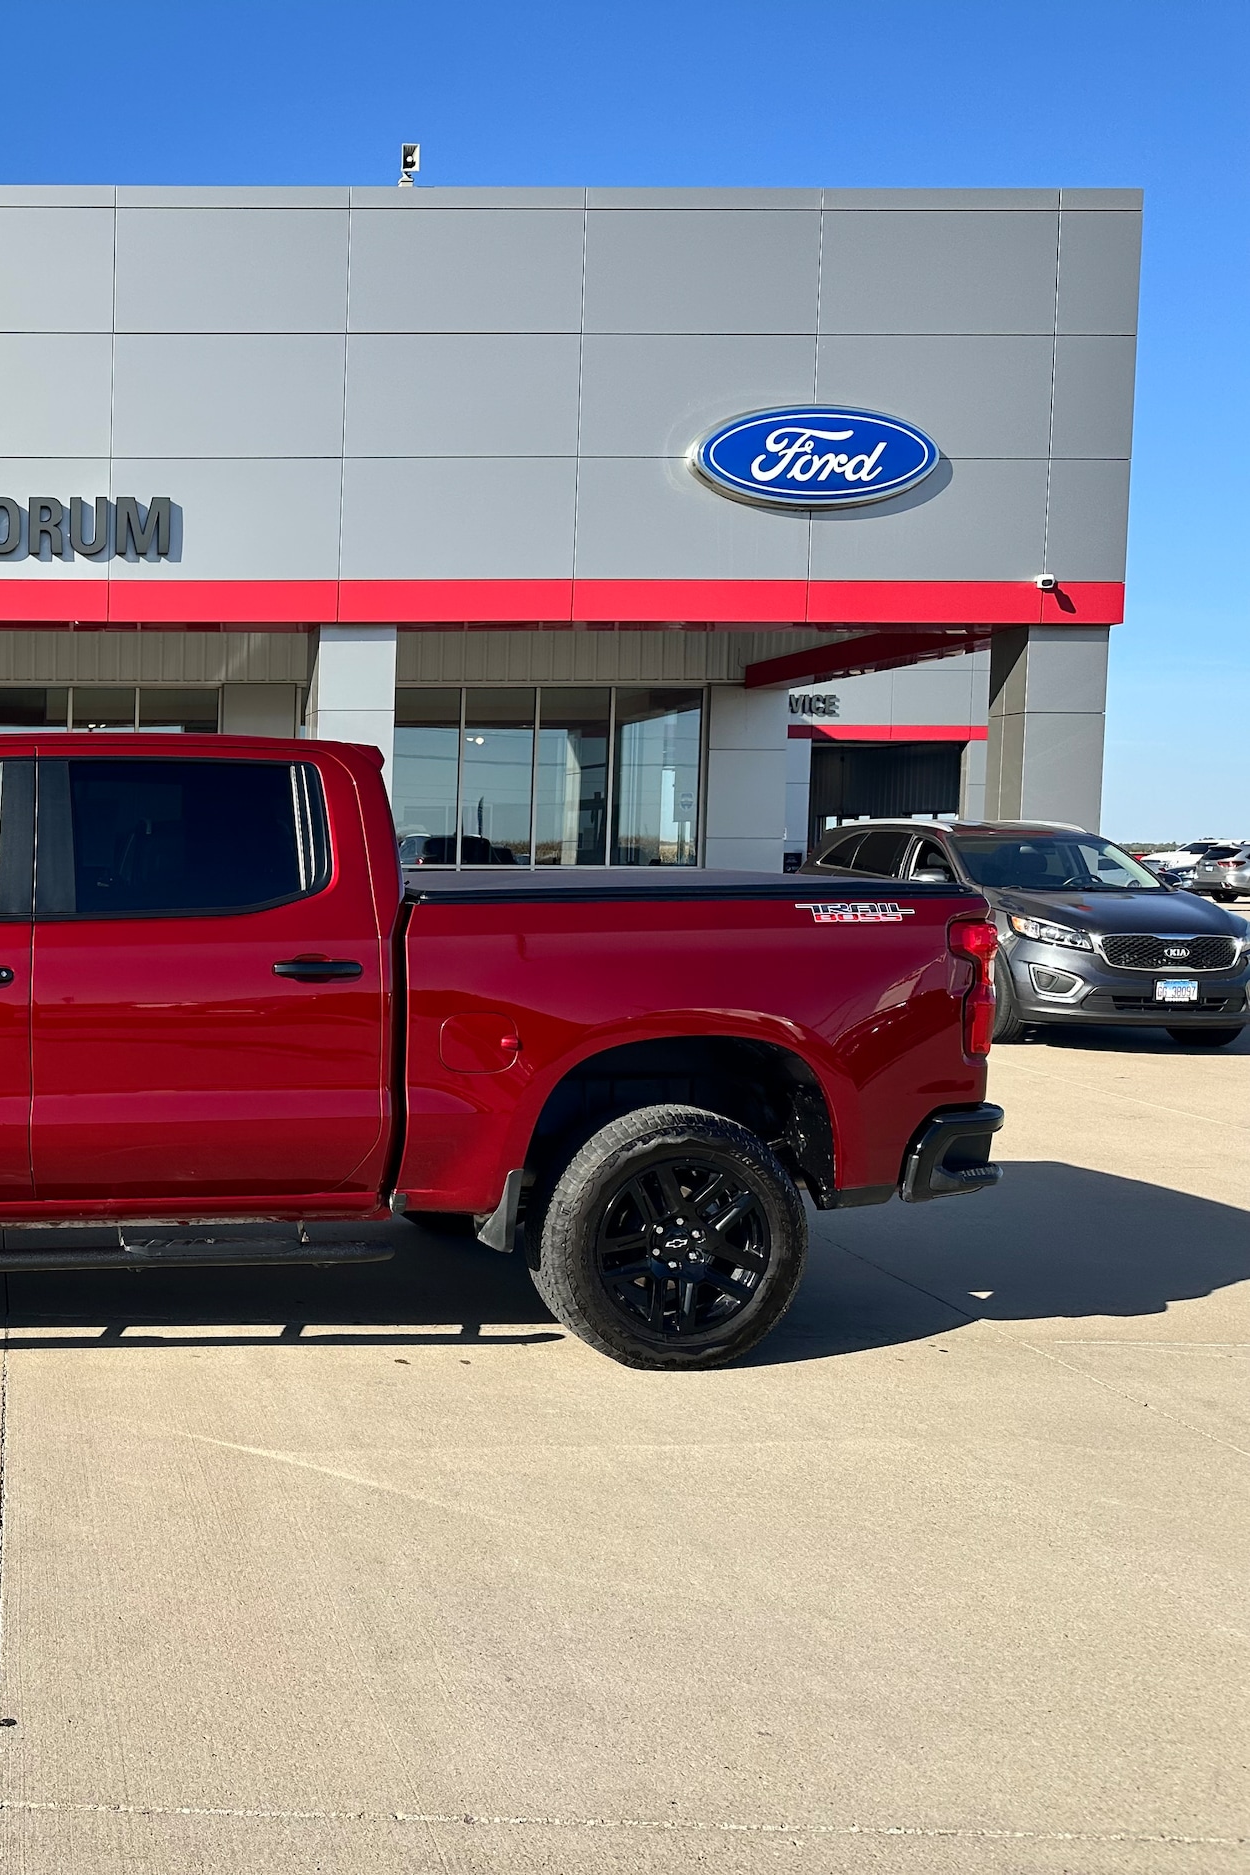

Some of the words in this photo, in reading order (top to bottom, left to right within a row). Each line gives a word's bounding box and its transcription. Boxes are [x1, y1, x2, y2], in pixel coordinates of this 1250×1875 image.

[749, 426, 888, 482] Ford
[795, 903, 915, 914] TRAIL
[813, 912, 903, 923] BOSS
[1169, 948, 1188, 957] KIA
